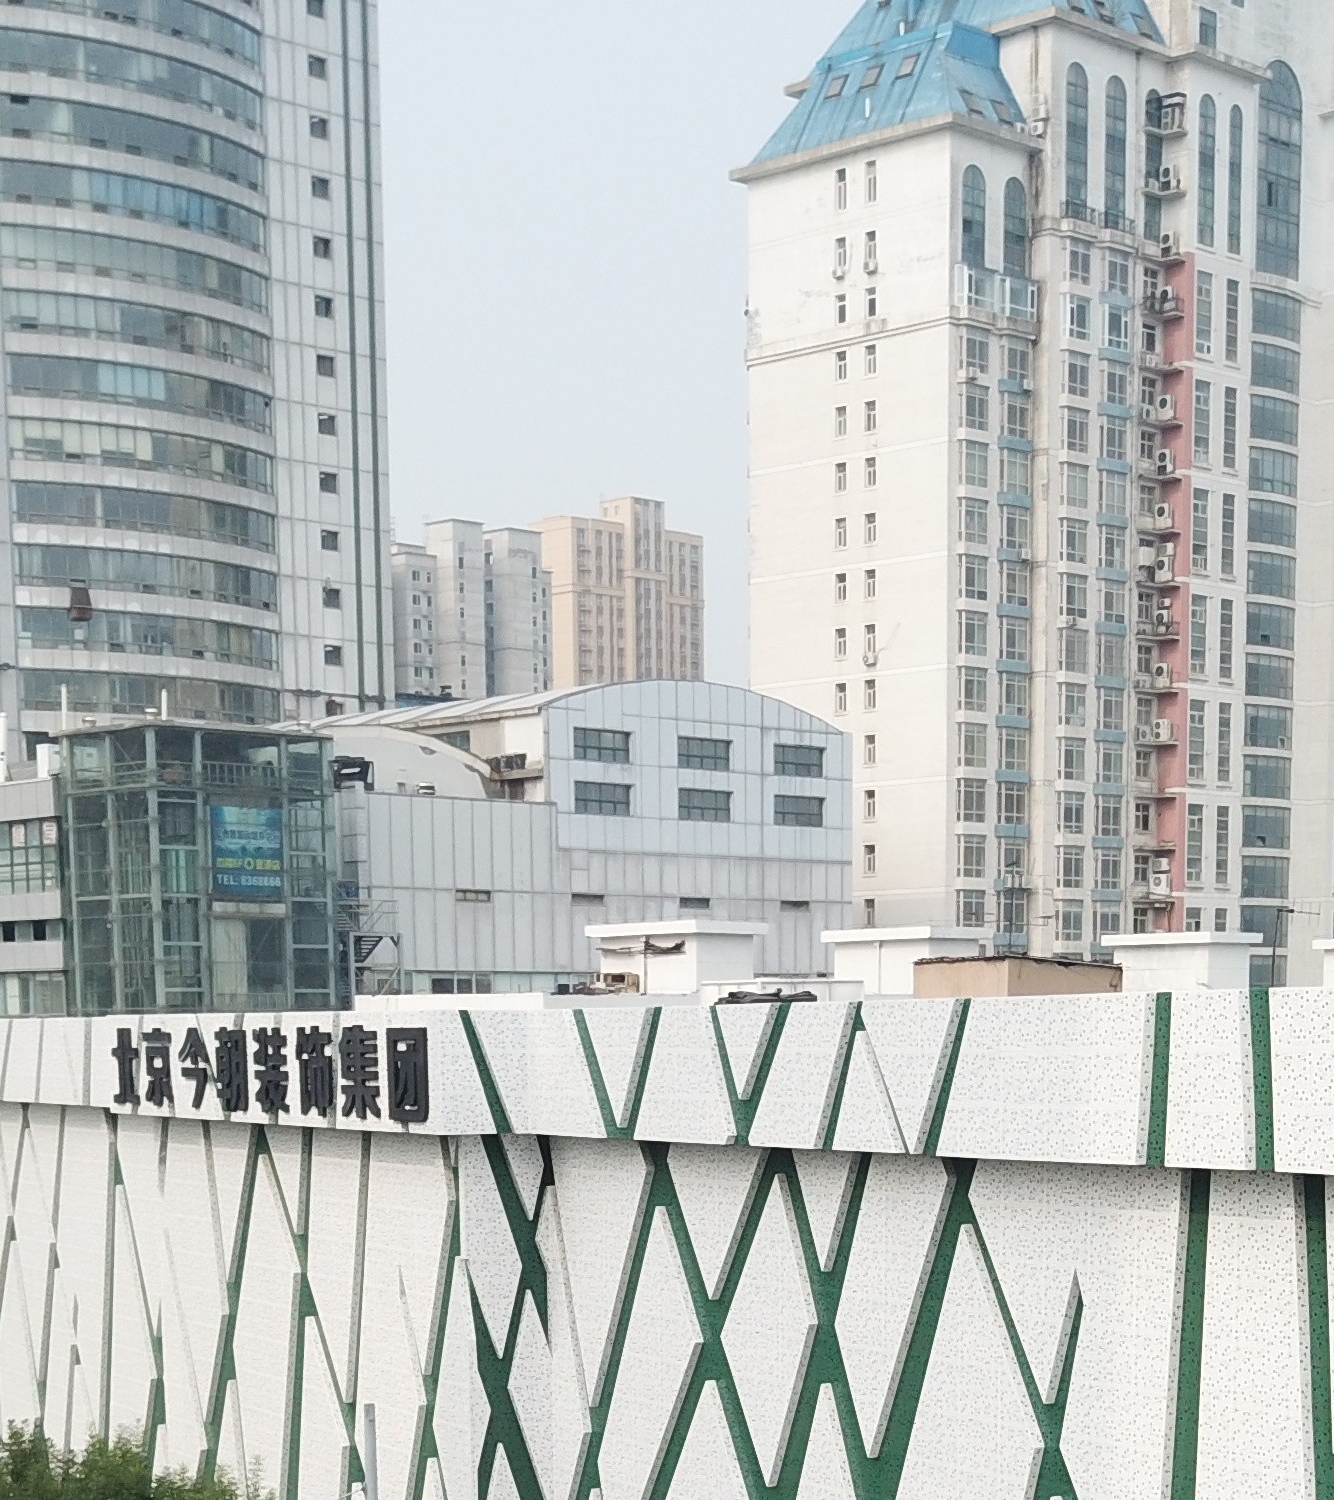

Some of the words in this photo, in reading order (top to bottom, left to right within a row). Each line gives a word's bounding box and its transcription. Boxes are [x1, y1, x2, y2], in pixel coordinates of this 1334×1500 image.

[111, 1025, 429, 1123] 北京今朝装饰集团
